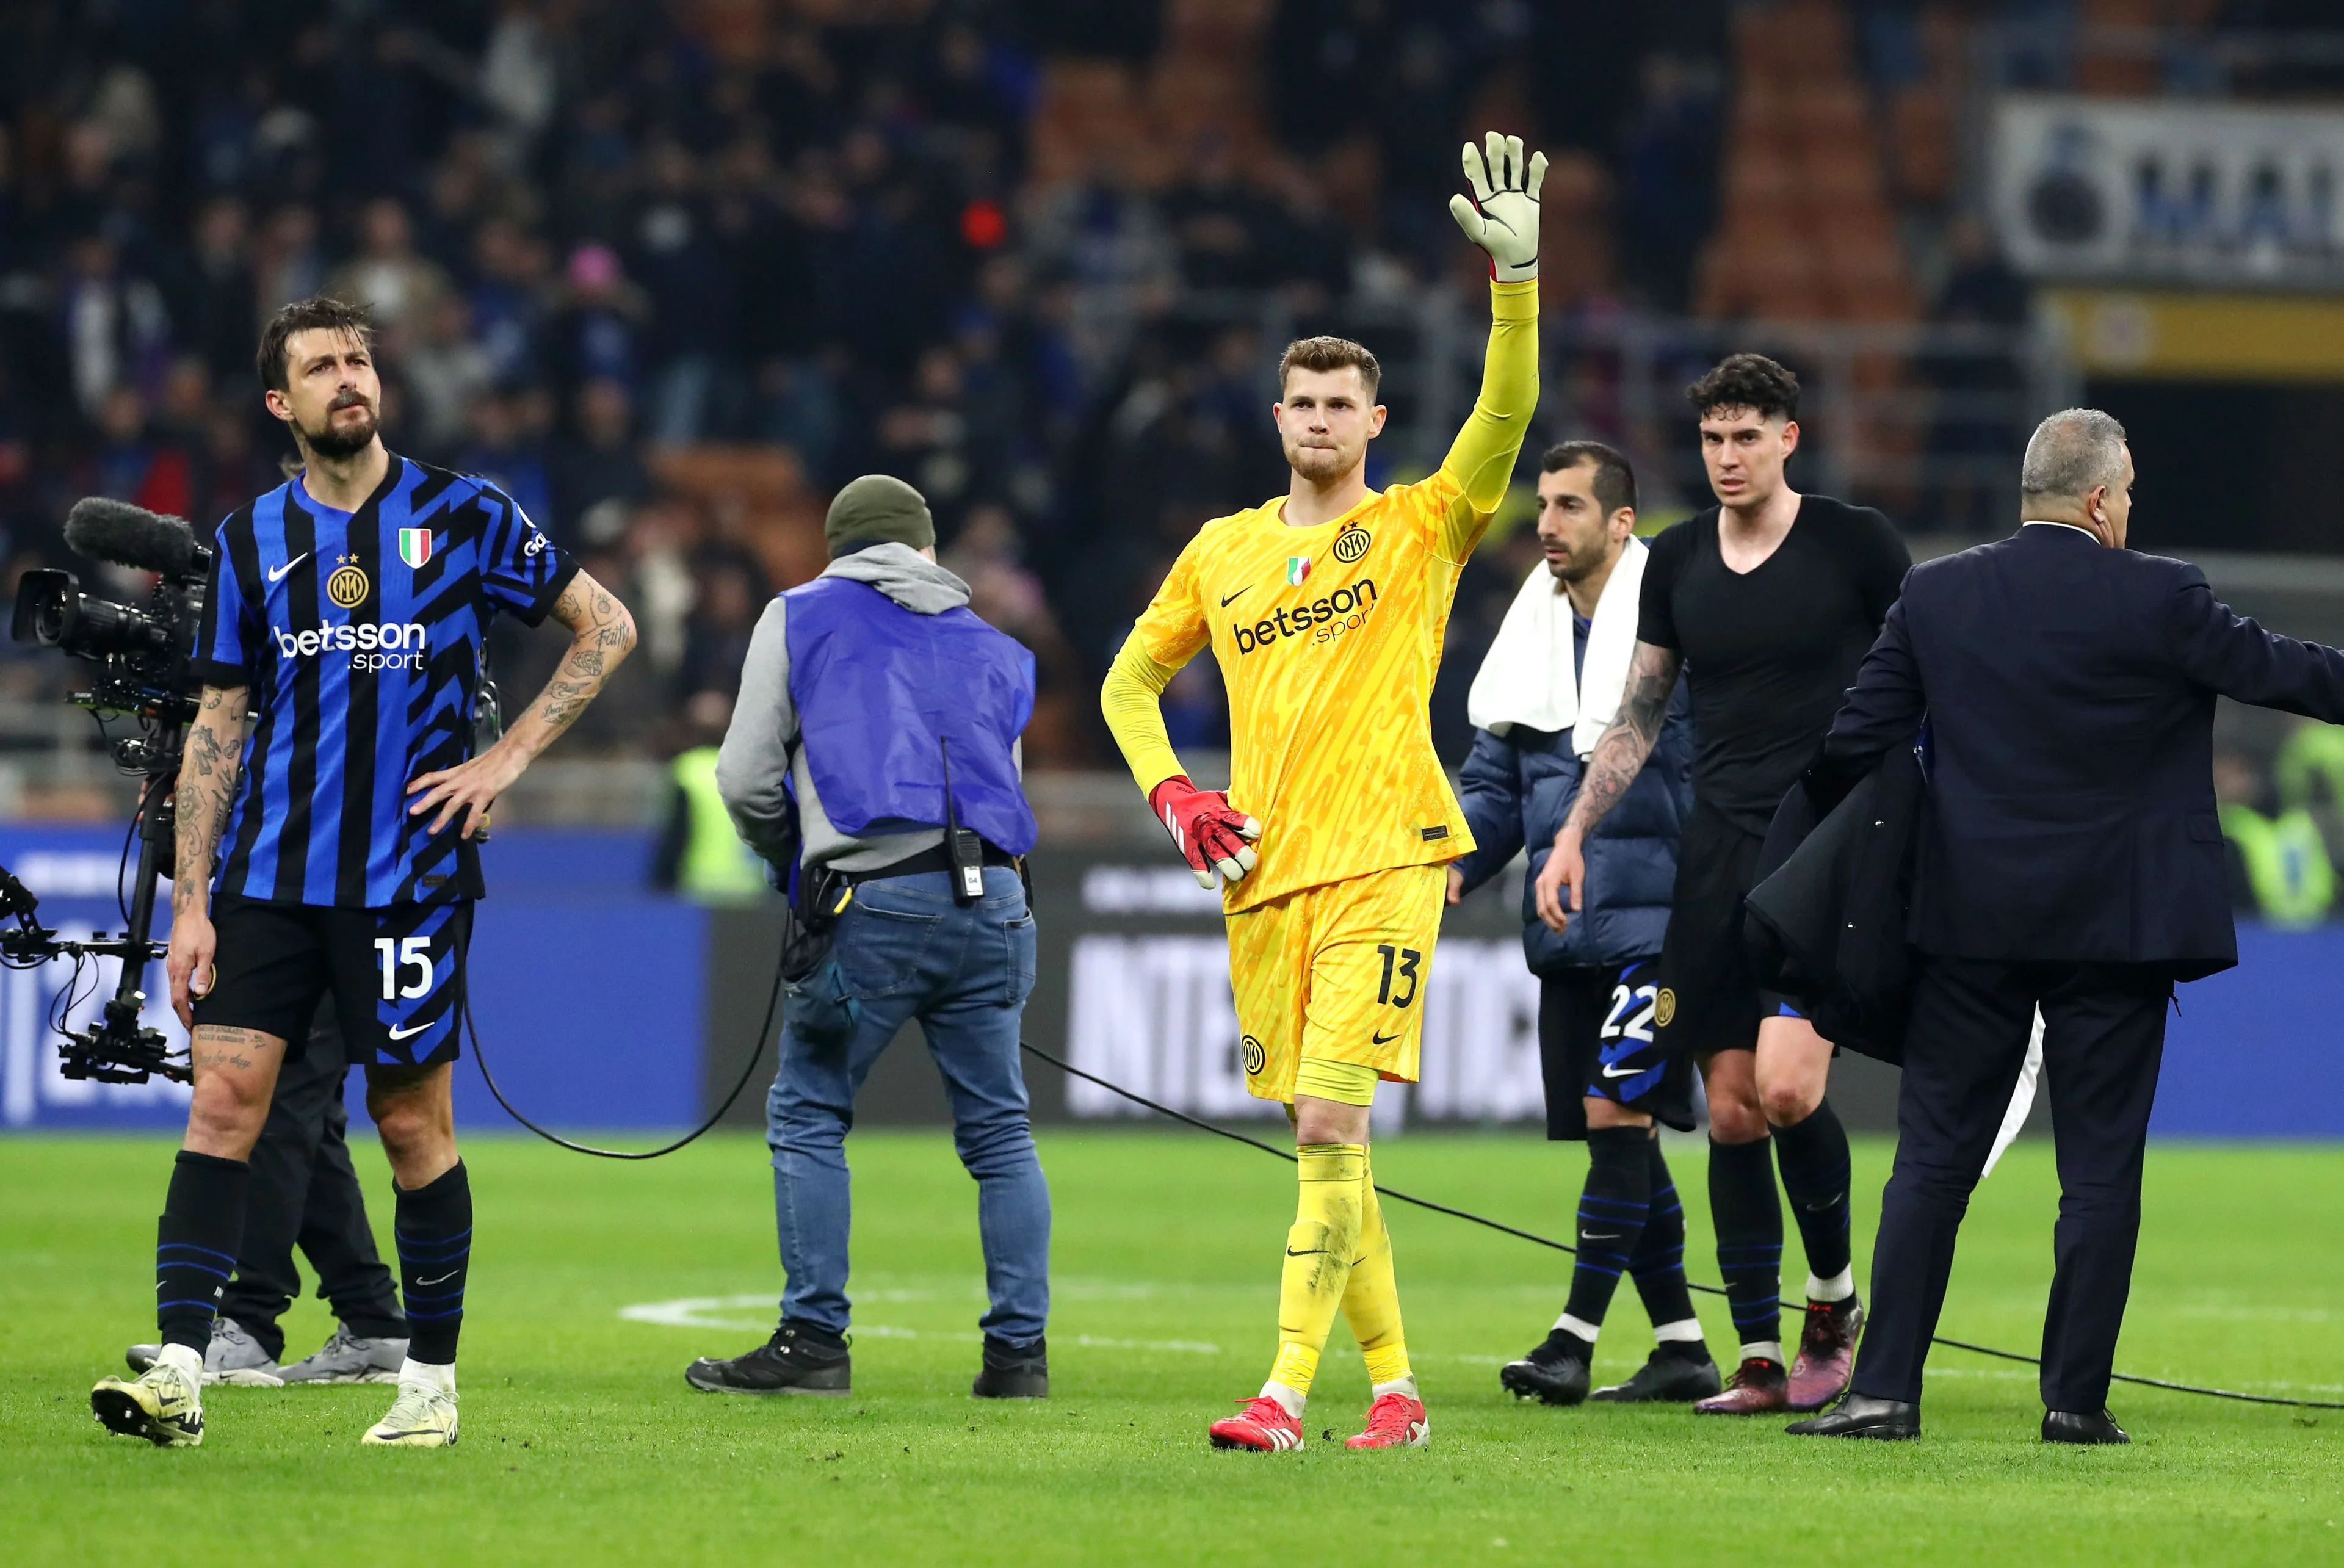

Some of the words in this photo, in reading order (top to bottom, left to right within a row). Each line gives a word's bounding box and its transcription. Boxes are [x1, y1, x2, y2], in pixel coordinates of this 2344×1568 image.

[274, 619, 425, 658] betsson
[1234, 579, 1378, 656] betsson
[347, 649, 424, 673] .sport
[374, 936, 433, 1000] 15
[1377, 945, 1421, 1008] 13
[1600, 984, 1658, 1042] 22
